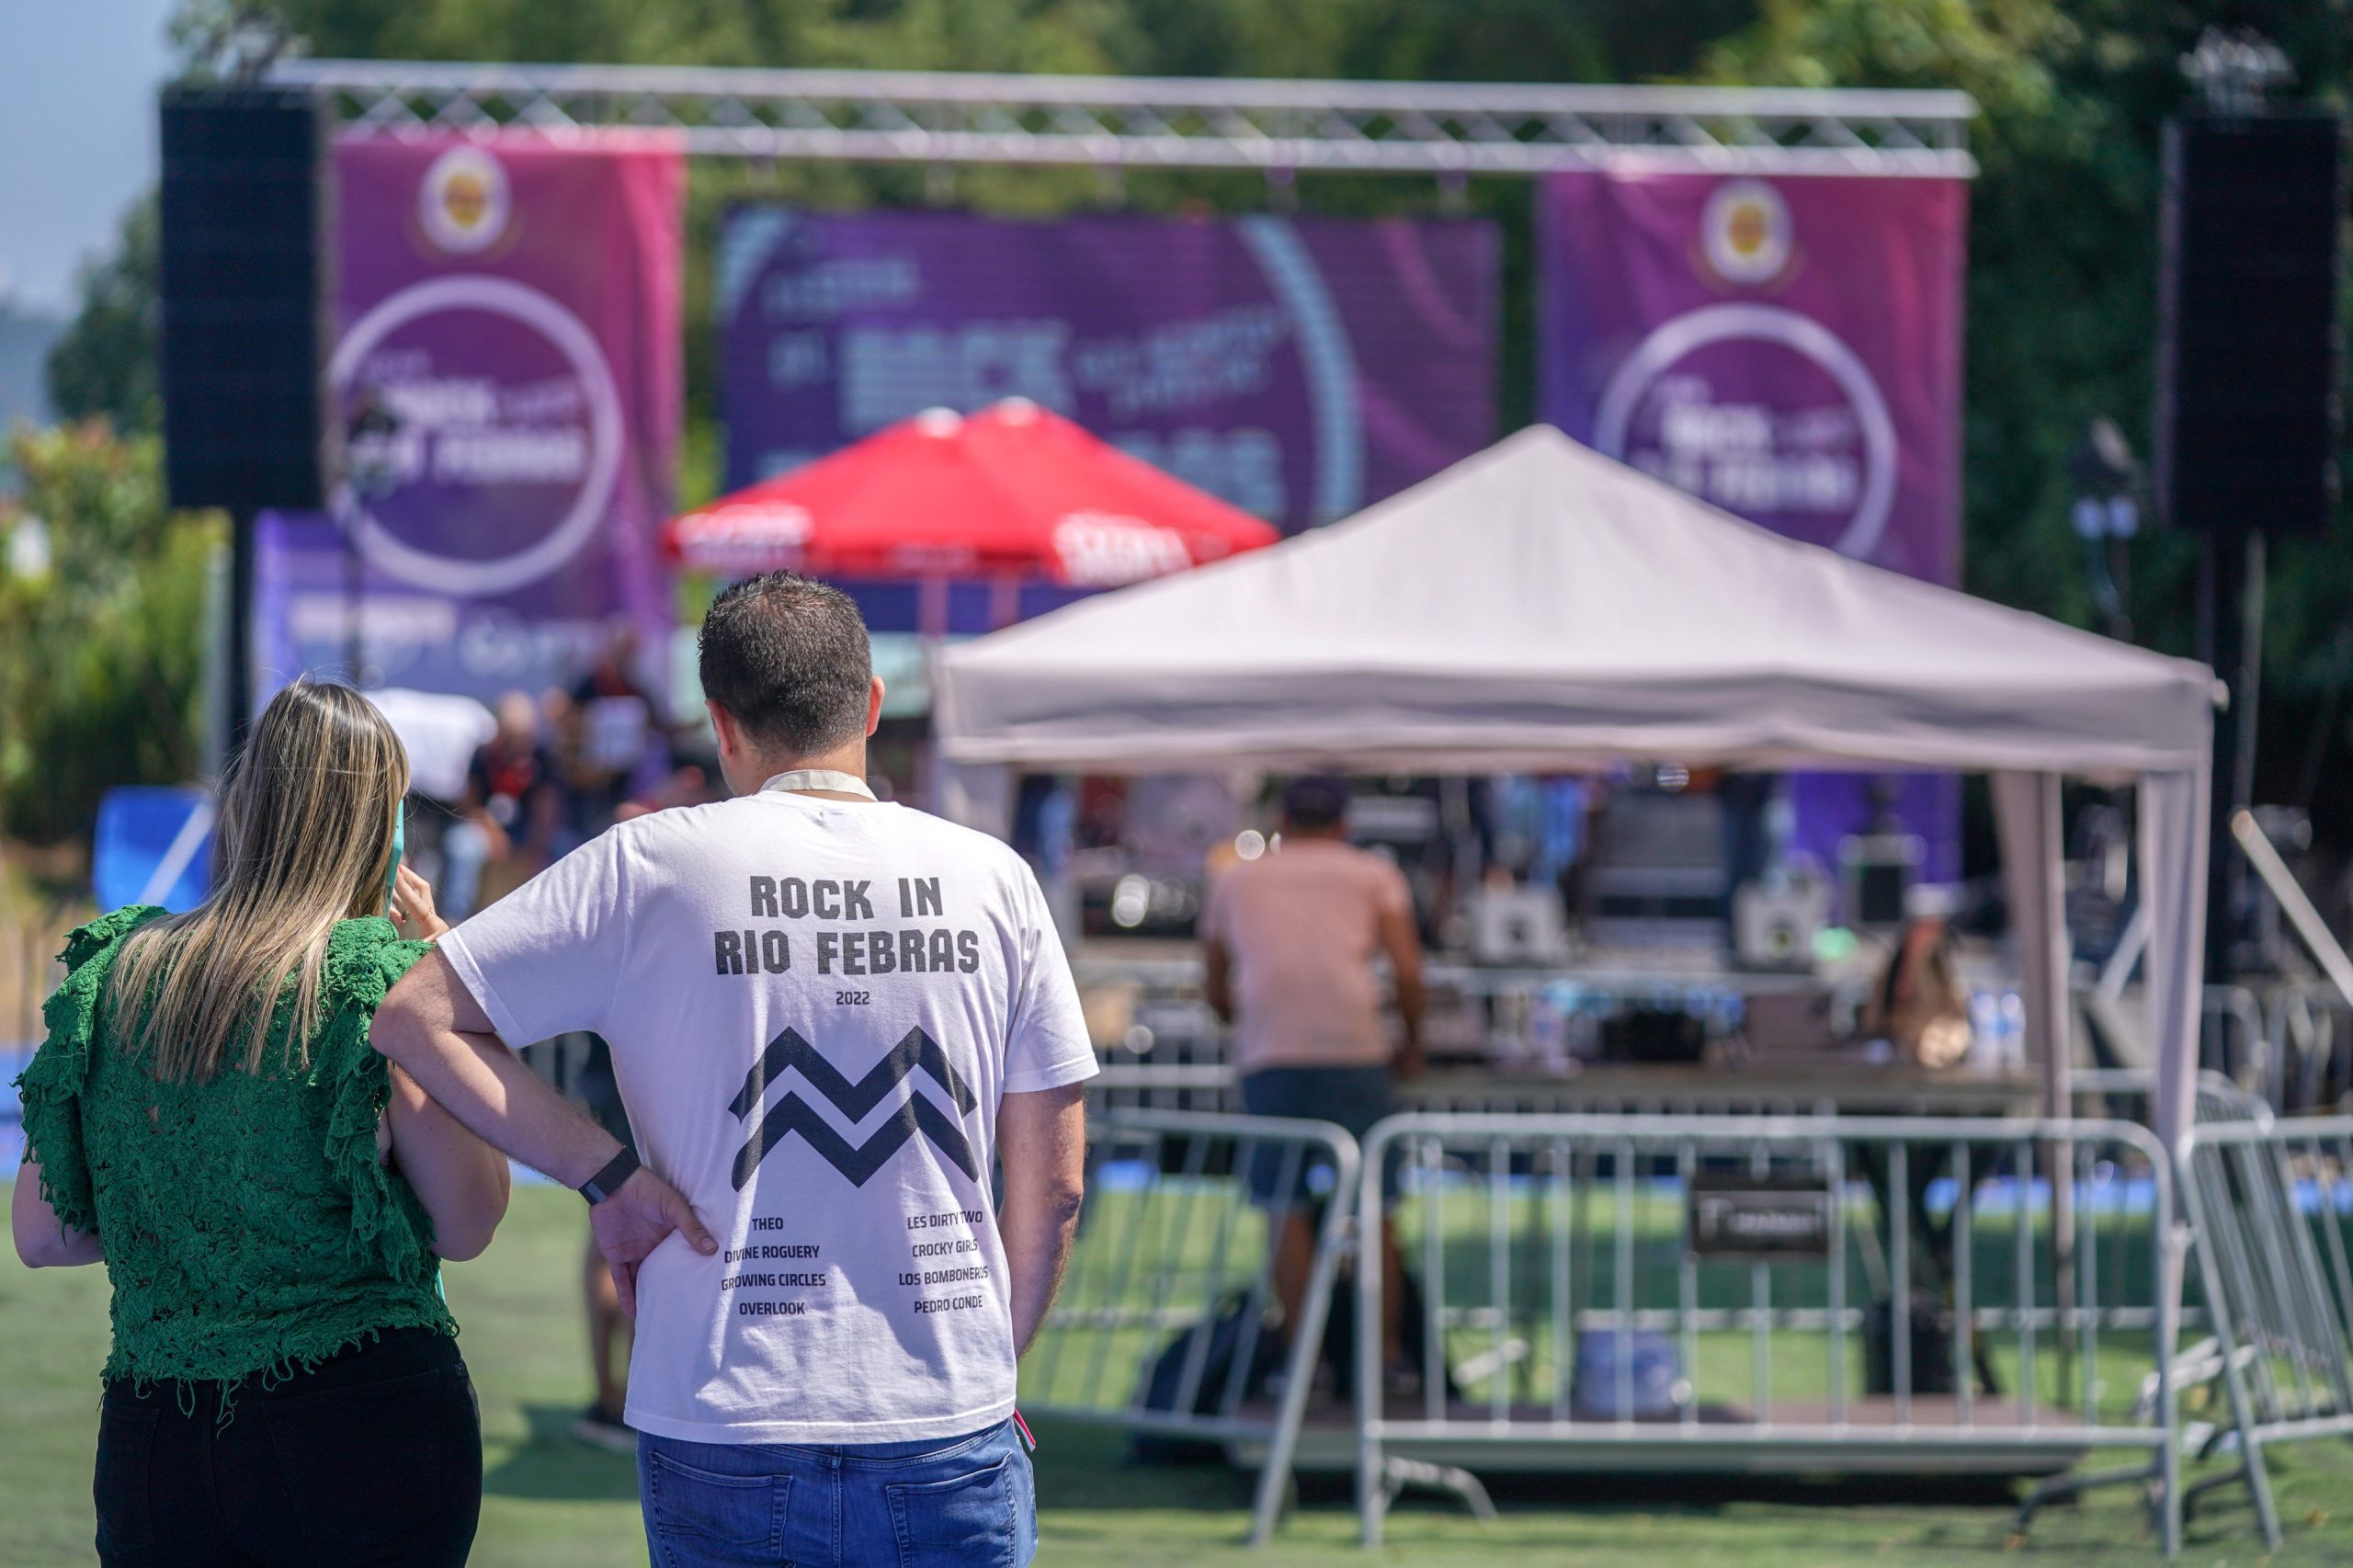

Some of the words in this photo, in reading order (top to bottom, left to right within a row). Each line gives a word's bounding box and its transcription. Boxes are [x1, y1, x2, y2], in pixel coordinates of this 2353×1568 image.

[750, 876, 874, 920] ROCK
[898, 877, 943, 918] IN
[714, 930, 790, 975] RIO
[816, 929, 980, 975] FEBRAS
[835, 991, 870, 1006] 2022
[752, 1217, 784, 1231] THEO
[907, 1215, 926, 1230] LES
[929, 1212, 959, 1227] DIRTY
[960, 1210, 983, 1223] TWO
[724, 1246, 759, 1263] DIVINE
[762, 1245, 820, 1258] ROGUERY
[912, 1242, 953, 1257] CROCKY
[956, 1239, 978, 1253] GIRLS
[721, 1274, 775, 1290] GROWING
[779, 1273, 826, 1287] CIRCLES
[899, 1273, 921, 1286] LOS
[924, 1266, 988, 1285] BOMBONEROS
[739, 1301, 805, 1315] OVERLOOK
[915, 1299, 949, 1313] PEDRO
[952, 1295, 983, 1310] CONDE
